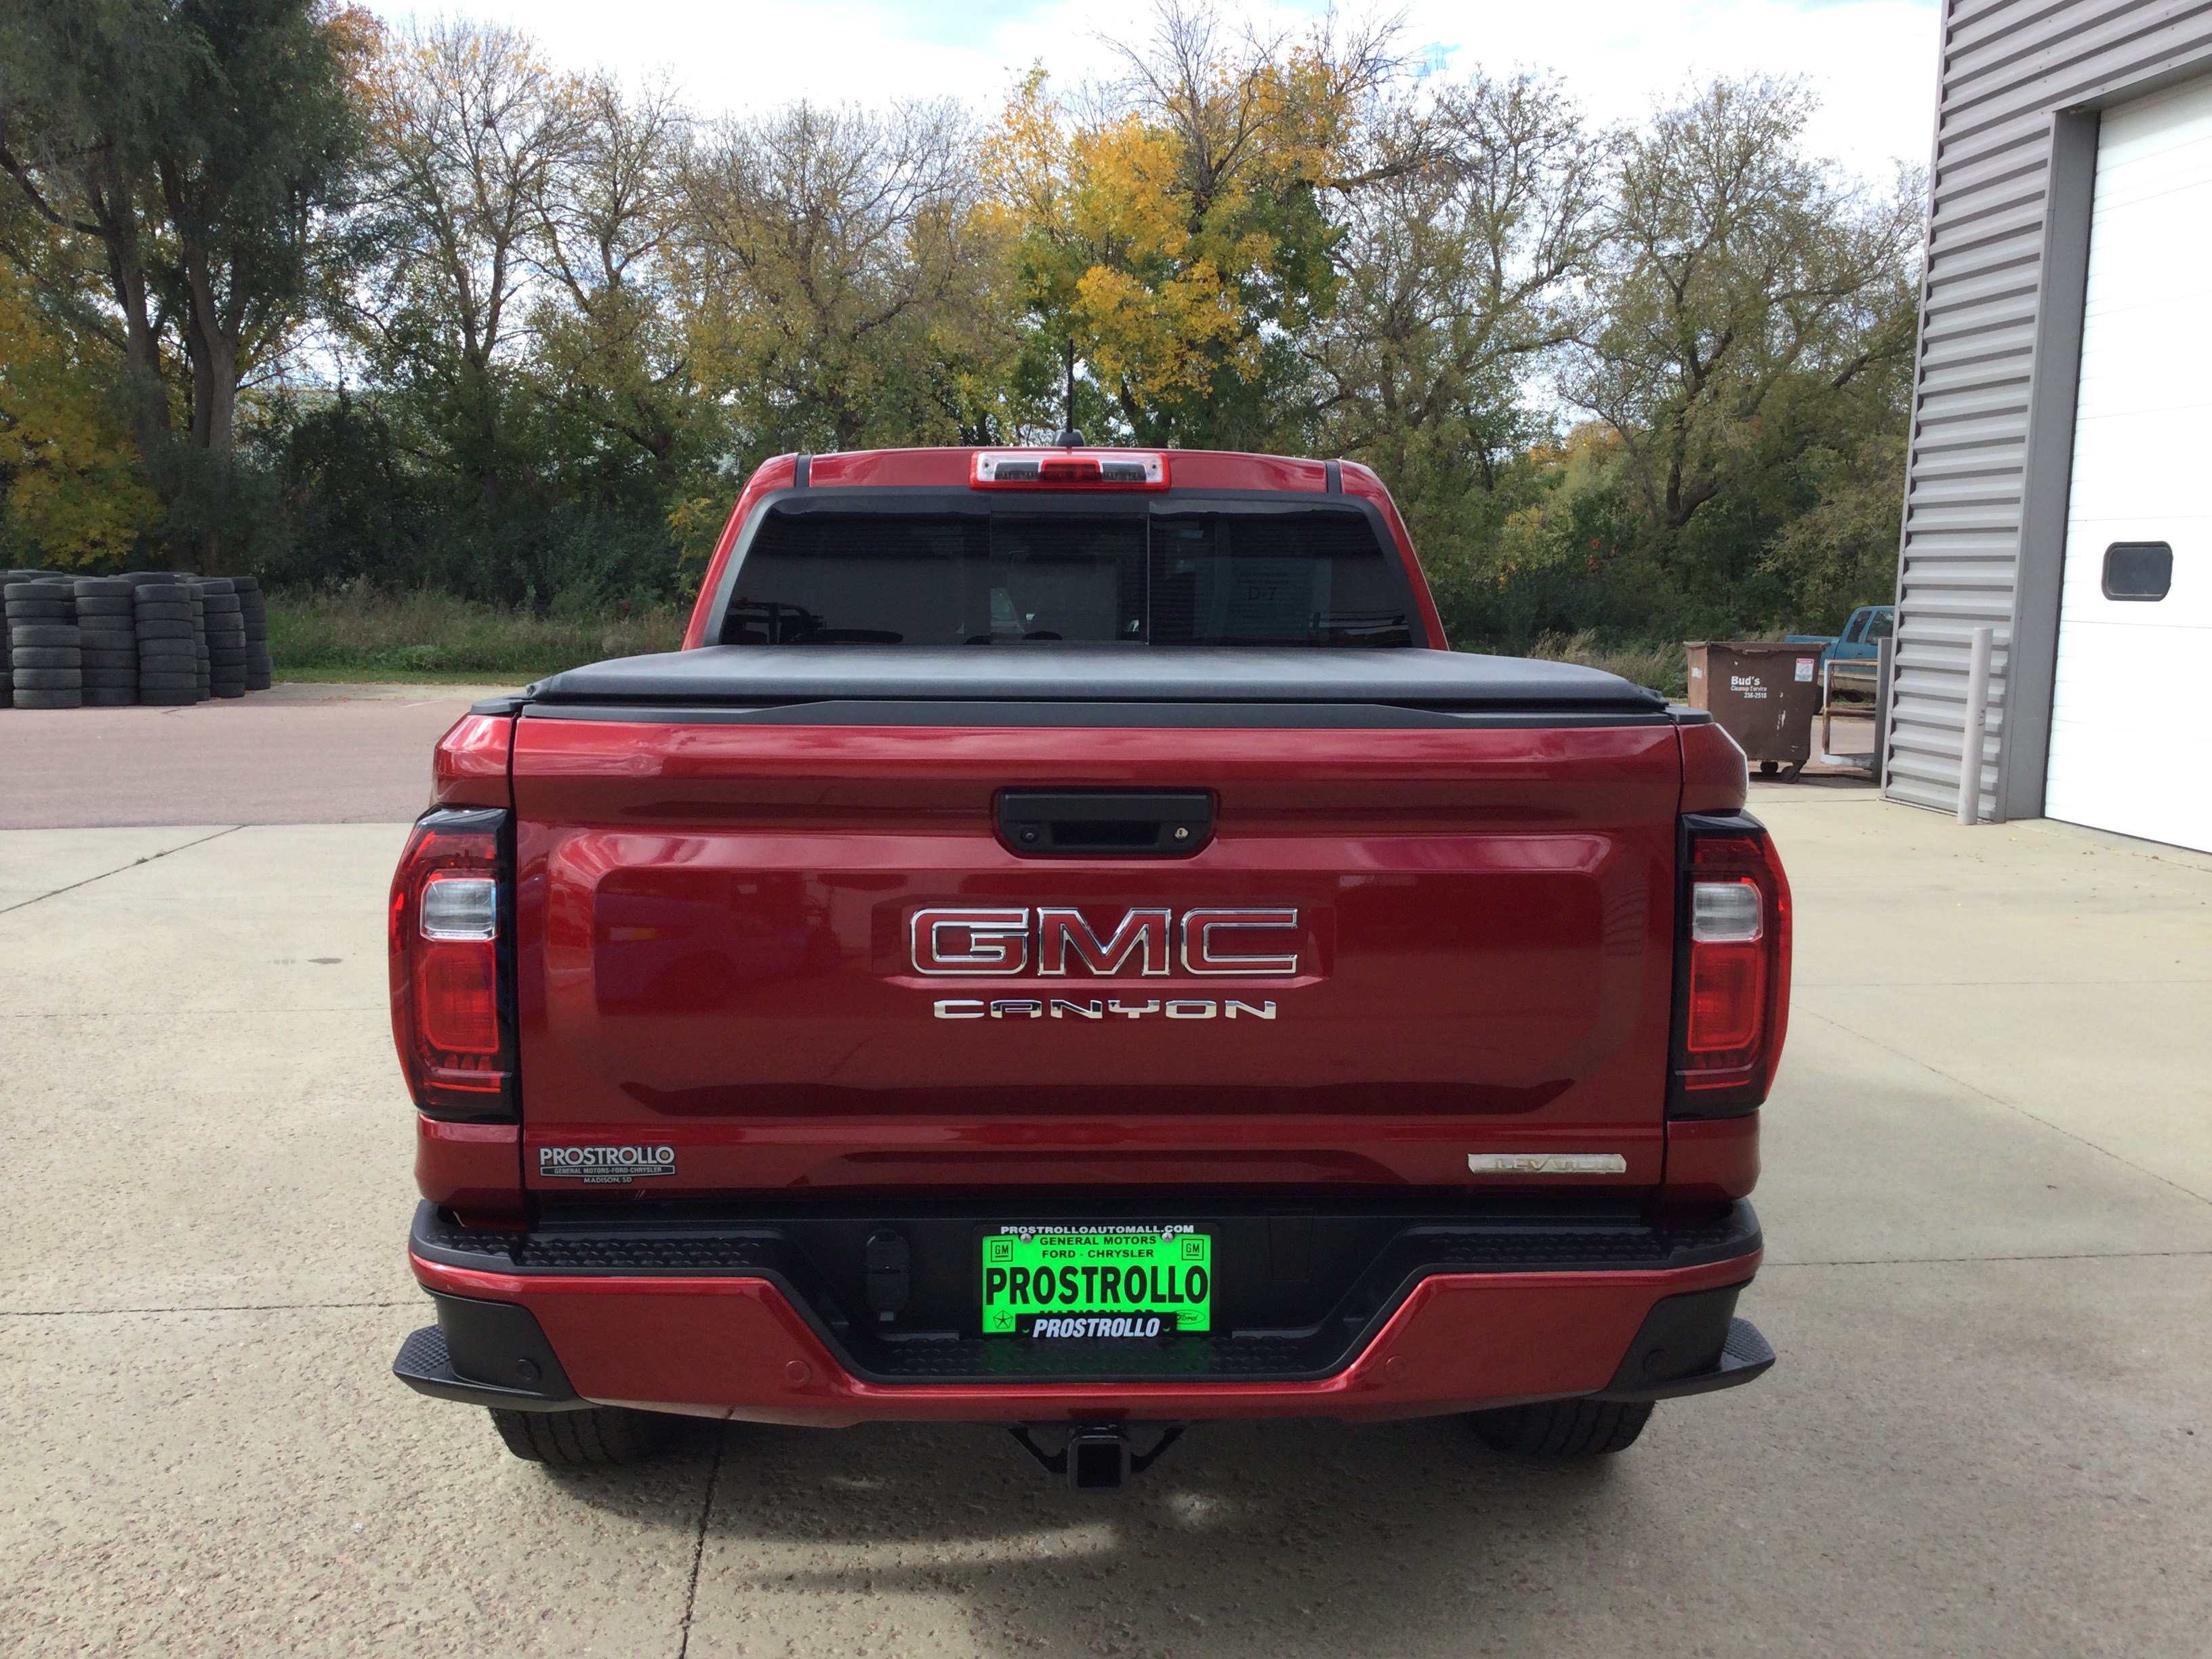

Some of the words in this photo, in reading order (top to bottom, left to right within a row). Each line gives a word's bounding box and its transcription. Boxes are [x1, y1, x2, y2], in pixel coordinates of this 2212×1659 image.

[1731, 676, 1761, 686] Bud's
[910, 907, 1298, 977] GMC
[933, 999, 1277, 1019] CANYON
[539, 1145, 675, 1166] PROSTROLLO
[1001, 1225, 1194, 1235] PROSTROLLOAUTOMALL.COM
[1040, 1236, 1099, 1246] GENERAL
[1103, 1235, 1157, 1245] MOTORS
[995, 1244, 1009, 1254] GM
[1185, 1243, 1200, 1253] GM
[1042, 1250, 1076, 1258] FORD
[1087, 1249, 1154, 1258] CHRYSLER
[986, 1265, 1208, 1305] PROSTROLLO
[1176, 1313, 1198, 1321] Ford
[1033, 1317, 1160, 1338] PROSTROLLO
